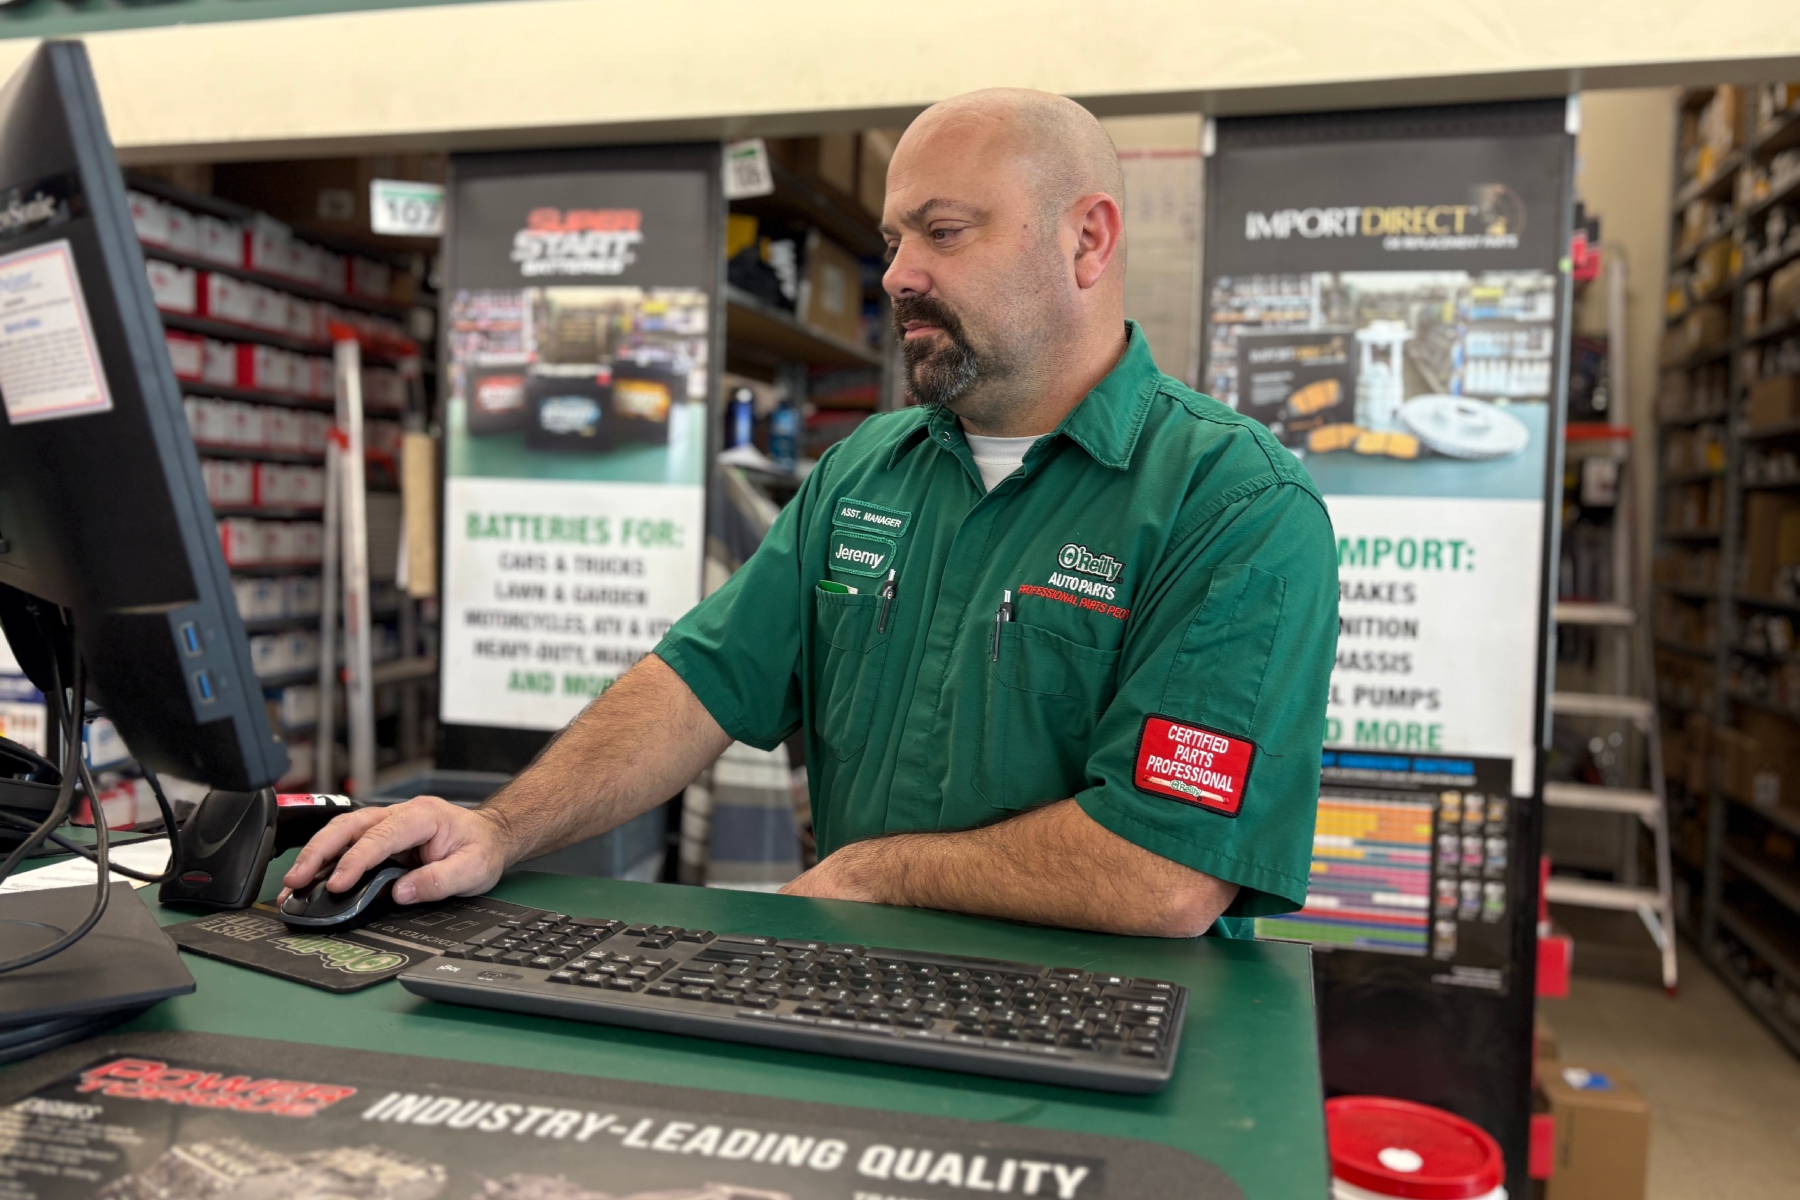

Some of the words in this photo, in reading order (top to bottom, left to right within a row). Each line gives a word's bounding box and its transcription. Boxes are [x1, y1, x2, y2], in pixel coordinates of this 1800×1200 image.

[527, 206, 642, 233] SUPER
[510, 229, 643, 263] START
[466, 512, 611, 545] BATTERIES
[621, 517, 685, 548] FOR:
[840, 507, 862, 520] ASST.
[863, 511, 902, 528] MANAGER
[499, 553, 547, 571] CARS
[574, 554, 644, 576] TRUCKS
[835, 543, 885, 570] Jeremy
[1059, 543, 1123, 582] O'Reilly
[1337, 537, 1475, 572] MPORT:
[495, 581, 545, 600] LAWN
[573, 585, 647, 605] GARDEN
[1018, 584, 1077, 606] PROFESSIONAL
[1079, 597, 1107, 613] PARTS
[1338, 580, 1417, 605] RAKES
[1338, 616, 1419, 640] NITION
[1336, 650, 1413, 675] HASSIS
[508, 669, 555, 694] AND
[1353, 684, 1441, 711] PUMPS
[1167, 725, 1229, 753] CERTIFIED
[1354, 719, 1444, 752] MORE
[1174, 745, 1213, 768] PARTS
[1146, 755, 1234, 793] PROFESSIONAL
[201, 923, 268, 941] FIRST
[399, 929, 459, 947] EDICATED
[277, 937, 402, 973] O'Reilly
[80, 1058, 357, 1104] POWER
[361, 1092, 849, 1171] INDUSTRY-LEADING
[856, 1143, 1090, 1200] QUALITY
